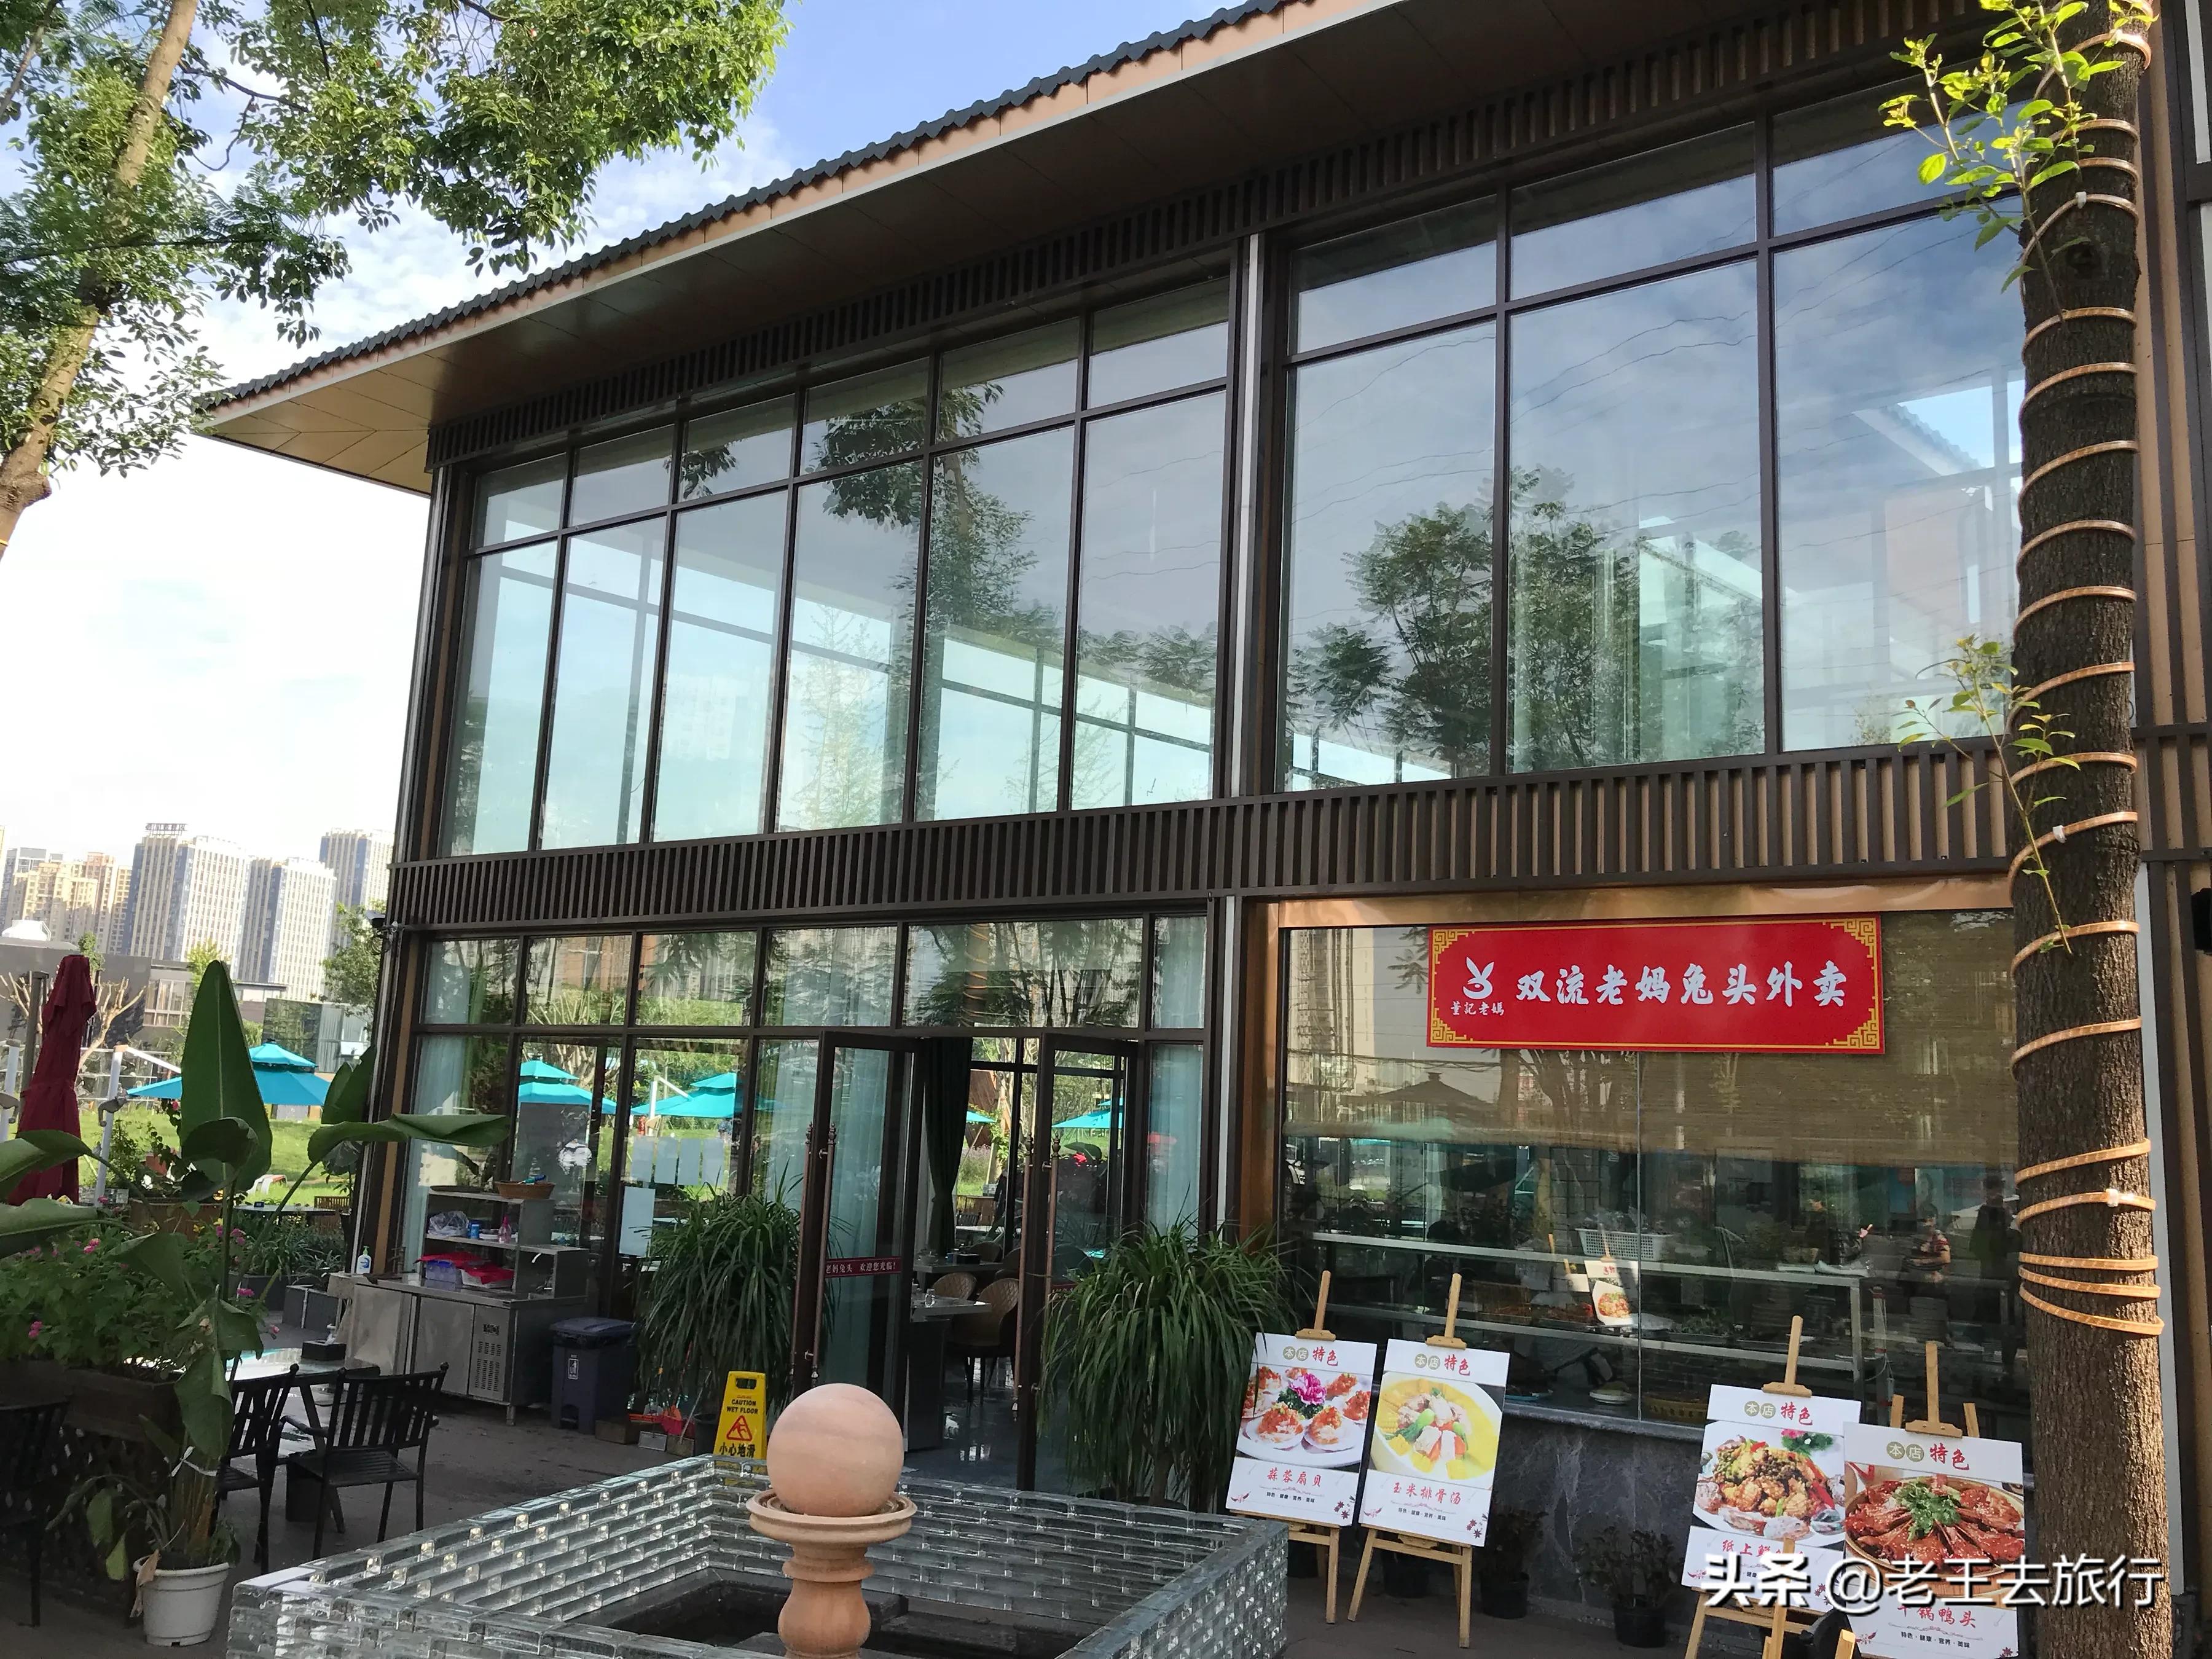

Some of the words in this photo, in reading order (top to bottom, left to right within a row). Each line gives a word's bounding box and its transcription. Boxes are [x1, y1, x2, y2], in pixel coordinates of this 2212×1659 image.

[1515, 960, 1847, 1007] 双流老妈兔头外卖
[1282, 1346, 1339, 1367] 本店特色
[1414, 1354, 1471, 1376] 本店特色
[1744, 1400, 1813, 1426] 本店特色
[719, 1441, 756, 1458] 小心地滑
[1886, 1441, 1970, 1470] 本店特色
[1266, 1467, 1322, 1488] 蒜蓉扇贝
[1393, 1482, 1461, 1505] 玉米排骨汤
